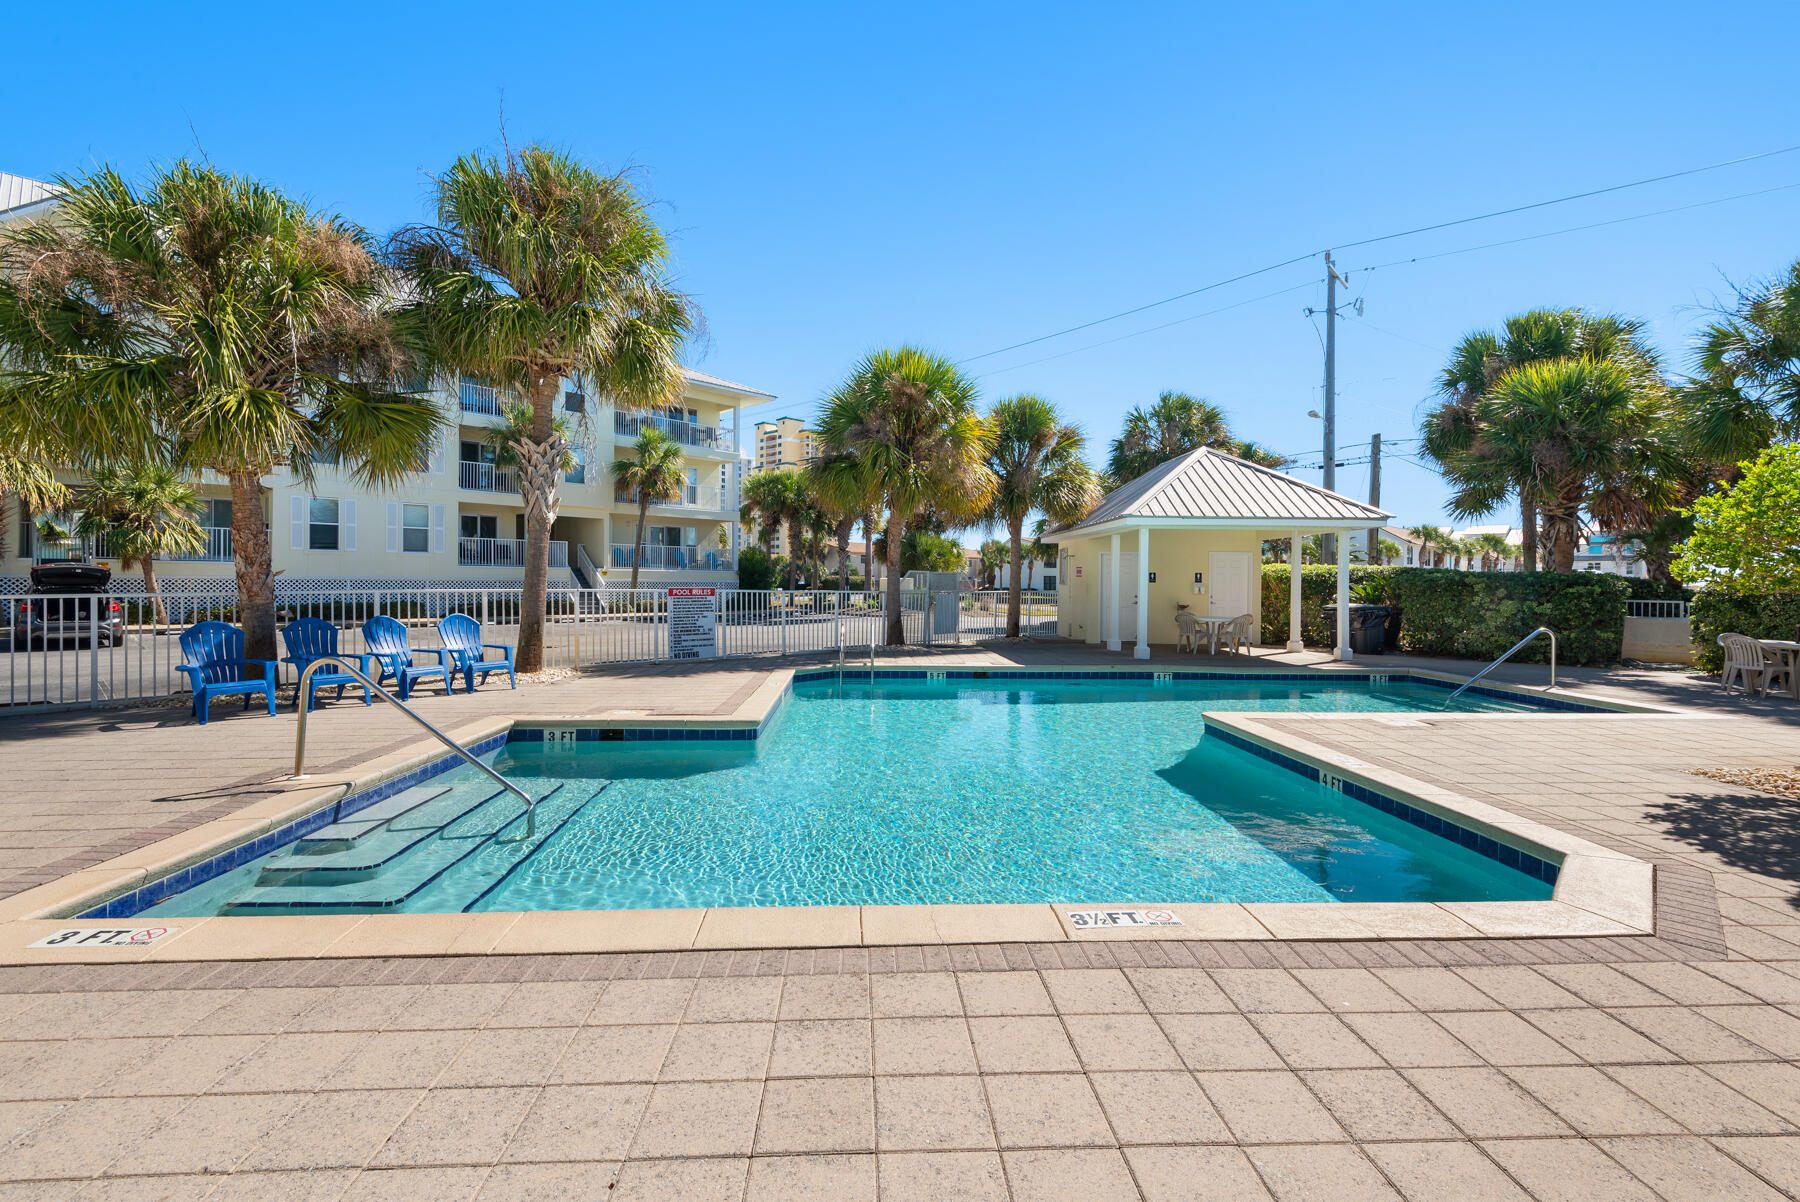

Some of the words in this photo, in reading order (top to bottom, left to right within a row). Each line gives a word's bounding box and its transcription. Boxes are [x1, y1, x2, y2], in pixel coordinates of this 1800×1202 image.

[682, 651, 700, 659] DIVING
[548, 731, 556, 742] 3
[560, 731, 575, 742] FT
[1322, 773, 1328, 787] 4
[1331, 776, 1342, 792] FT
[46, 931, 81, 945] 3
[77, 930, 132, 944] FT.
